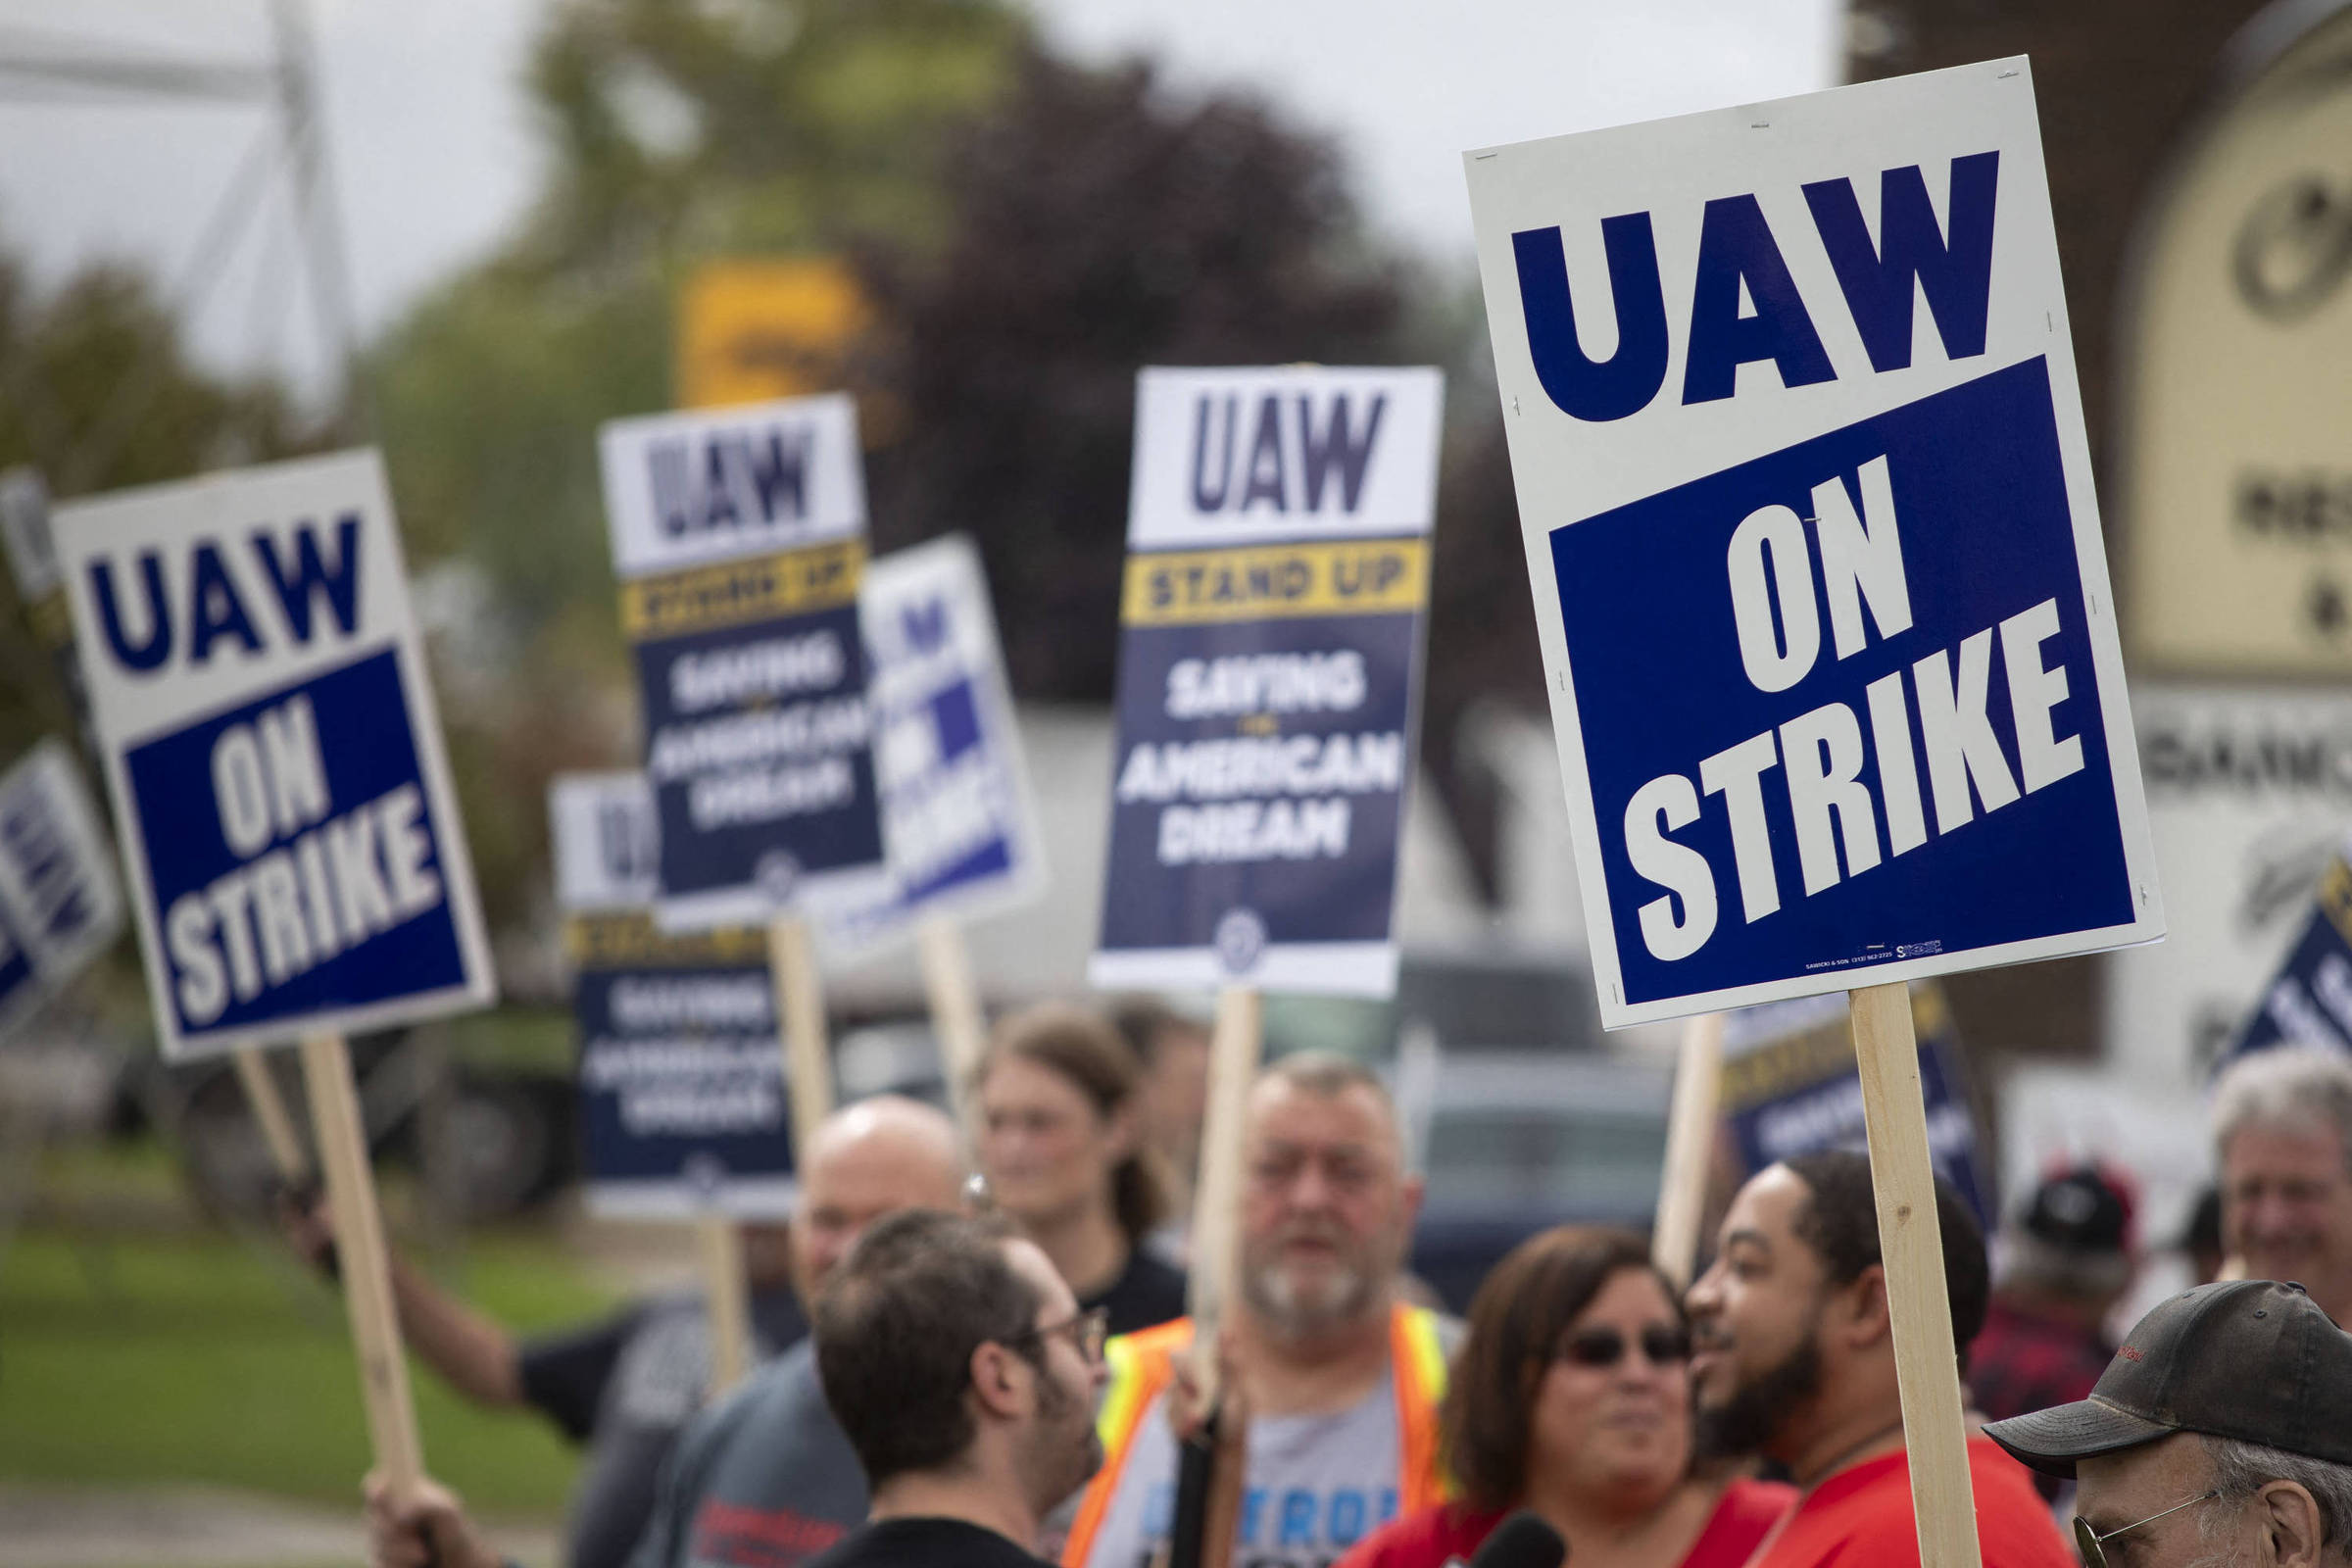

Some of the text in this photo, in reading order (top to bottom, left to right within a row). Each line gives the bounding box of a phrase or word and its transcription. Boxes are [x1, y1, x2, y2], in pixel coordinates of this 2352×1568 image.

[1511, 150, 2001, 422] UAW
[645, 423, 815, 540] UAW
[1189, 388, 1389, 518] UAW
[86, 514, 363, 674] UAW
[1150, 553, 1405, 610] STAND UP
[1727, 453, 1914, 694] ON
[1164, 648, 1367, 721] SAVING
[209, 692, 330, 859] ON
[1116, 729, 1402, 805] AMERICAN
[1156, 796, 1351, 865] DREAM
[1623, 596, 2085, 961] STRIKE
[164, 782, 443, 1025] STRIKE
